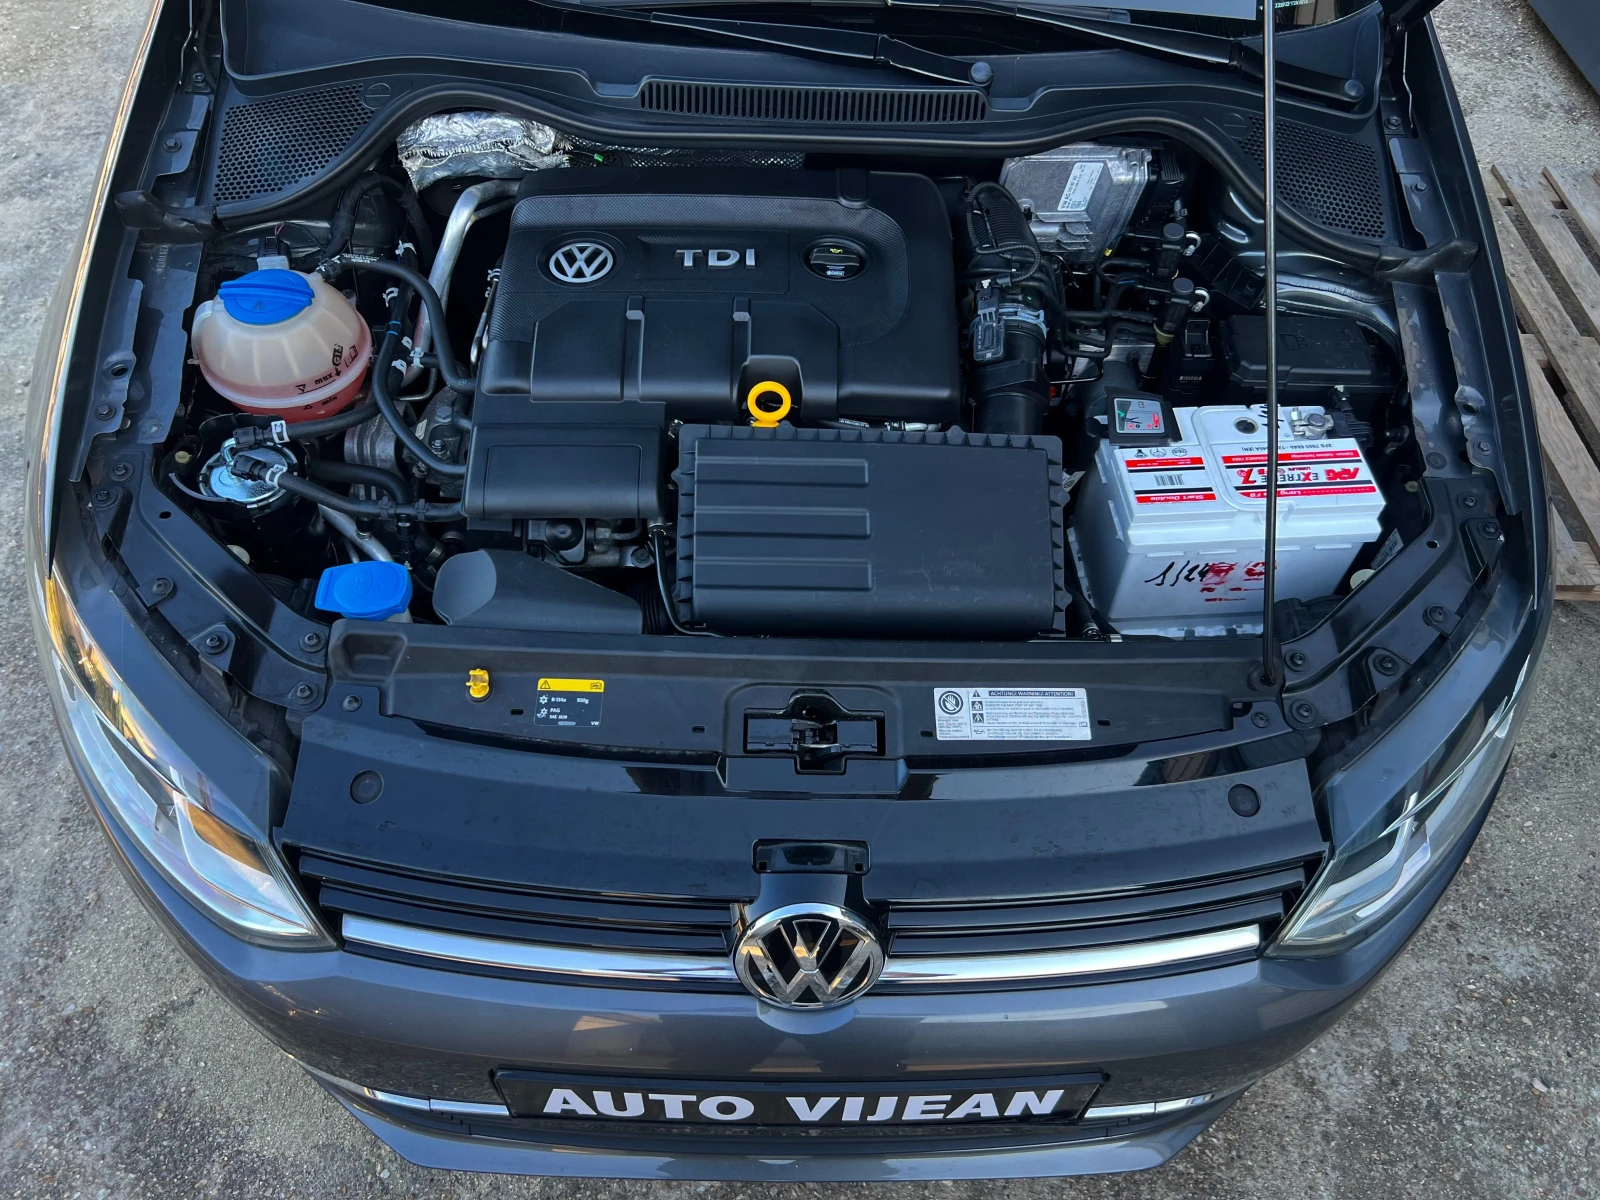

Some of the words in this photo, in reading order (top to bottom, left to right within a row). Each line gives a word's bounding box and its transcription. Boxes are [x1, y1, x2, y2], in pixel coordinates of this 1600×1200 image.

[549, 242, 614, 283] VW
[676, 249, 756, 268] TDI
[314, 372, 333, 385] max
[321, 396, 338, 406] min
[1261, 472, 1318, 482] EXTREE
[734, 903, 885, 1010] VW
[543, 1088, 755, 1121] AUTO
[785, 1089, 1065, 1121] VIJEAN
